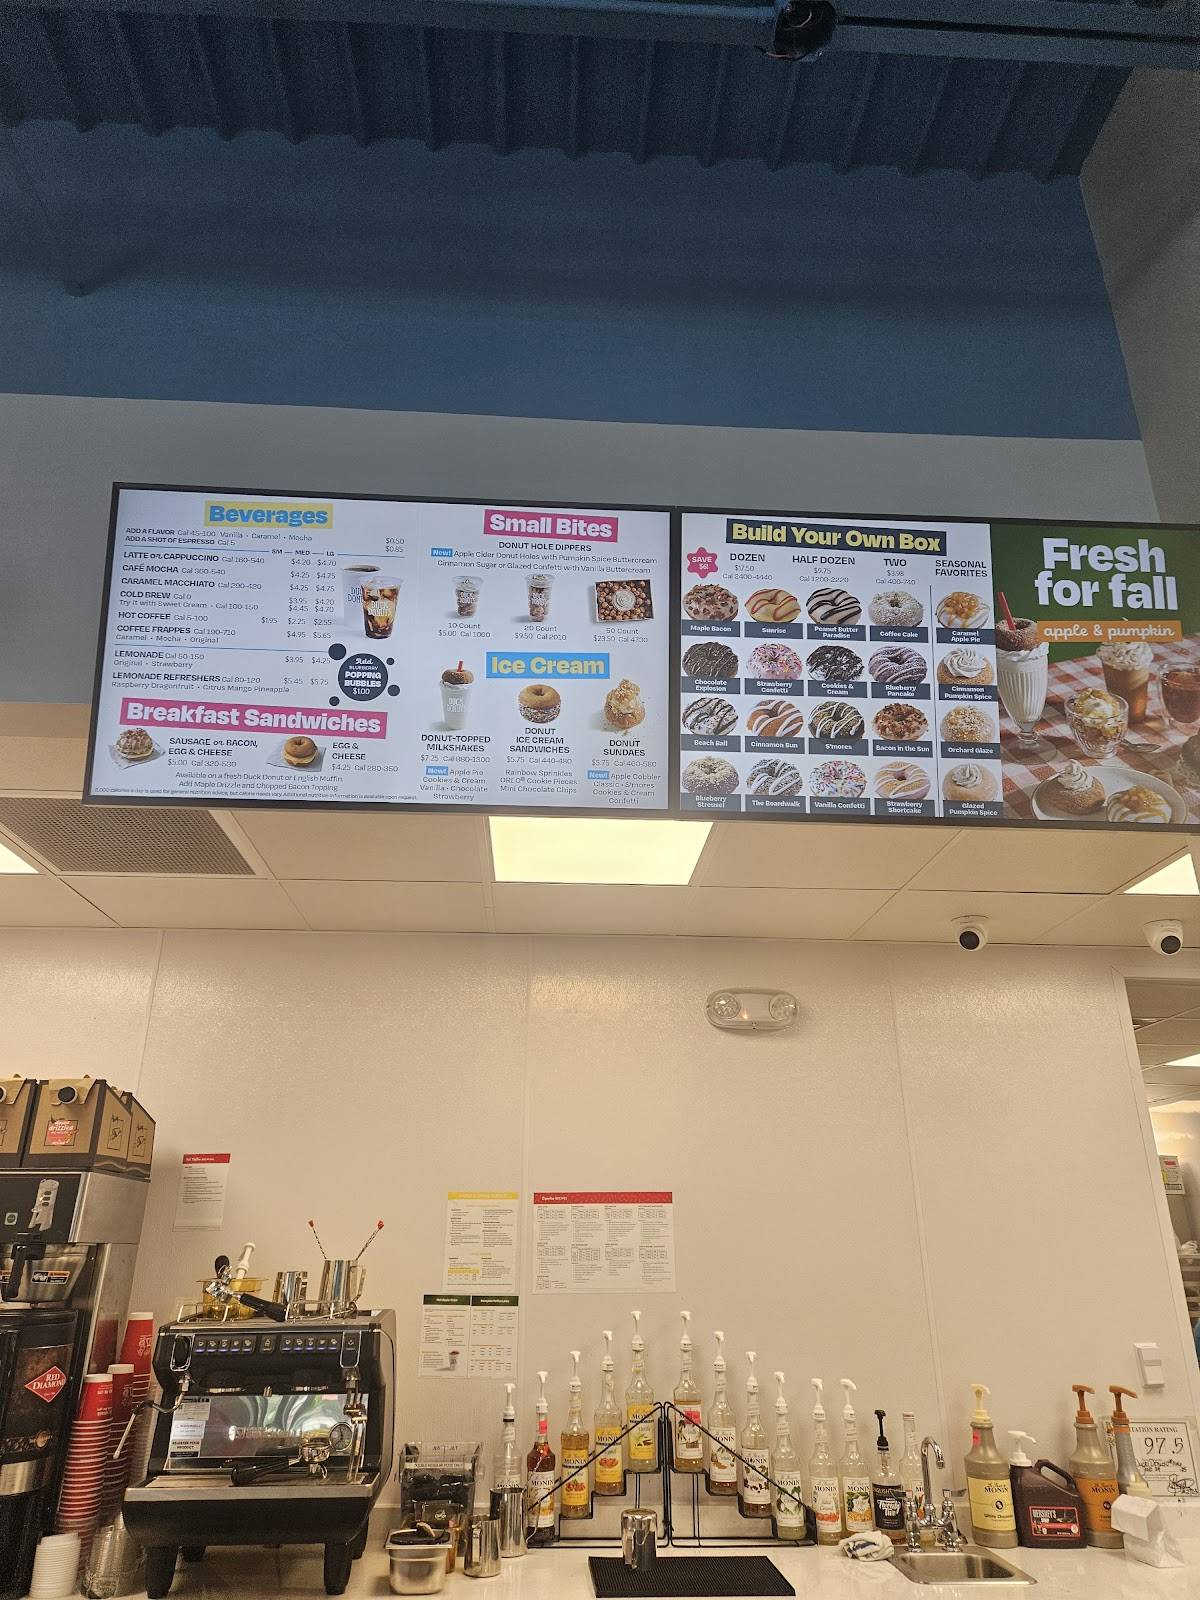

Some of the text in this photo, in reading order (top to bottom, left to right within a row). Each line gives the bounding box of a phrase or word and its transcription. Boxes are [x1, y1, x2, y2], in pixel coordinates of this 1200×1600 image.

[209, 505, 328, 527] Beverages
[490, 514, 613, 538] Small Bites
[147, 528, 175, 536] FLAVOR
[148, 536, 165, 544] SHOT
[178, 537, 215, 545] ESPRESSO
[732, 523, 941, 552] Build Your Own Box
[499, 542, 592, 552] DONUT HOLE DIPPERS
[123, 551, 148, 560] LATTE
[163, 553, 219, 563] CAPPUCCINO
[454, 551, 474, 559] Apple
[559, 554, 590, 563] Pumpkin
[612, 556, 657, 564] Buttercream
[730, 553, 765, 562] DOZEN
[1043, 538, 1165, 573] Fresh
[477, 561, 497, 569] Sugar
[792, 556, 856, 565] HALF DOZEN
[883, 558, 907, 567] TWO
[935, 559, 987, 569] SEASONAL
[122, 563, 145, 572] CAFÉ
[146, 565, 179, 574] MOCHA
[935, 569, 988, 577] FAVORITES
[121, 577, 161, 586] CARAMEL
[163, 579, 215, 588] MACCHIATO
[120, 590, 171, 600] COLD BREW
[1035, 571, 1178, 610] for fall
[118, 611, 171, 621] HOT COFFEE
[117, 624, 191, 634] COFFEE FRAPPES
[814, 625, 837, 633] Peanut
[1044, 625, 1175, 640] apple & pumpkin
[880, 630, 900, 638] Coffee
[114, 650, 164, 659] LEMONADE
[113, 659, 193, 669] Original Strawberry
[492, 657, 604, 674] Ice Cream
[112, 672, 221, 683] LEMONADE REFRESHERS
[345, 671, 382, 680] POPPING
[344, 679, 382, 688] BUBBLES
[695, 679, 727, 687] Chocolate
[757, 681, 792, 689] Strawberry
[696, 685, 727, 693] Explosion
[126, 702, 381, 733] Breakfast Sandwiches
[169, 737, 211, 746] SAUSAGE
[421, 735, 491, 743] DONUT-TOPPED
[332, 742, 351, 750] EGG
[426, 744, 485, 752] MILKSHAKES
[509, 745, 570, 753] SANDWICHES
[168, 748, 232, 757] EGG CHEESE
[331, 752, 366, 761] CHEESE
[603, 748, 645, 756] SUNDAES
[176, 771, 206, 779] Available
[449, 768, 469, 776] Apple
[423, 776, 453, 784] Cookies
[194, 781, 216, 789] Maple
[433, 793, 474, 801] Strawberry
[887, 801, 922, 809] Strawberry
[46, 1373, 60, 1381] RED
[33, 1379, 66, 1389] DIAMOND
[1144, 1437, 1184, 1455] 97.5
[1033, 1510, 1056, 1518] HERSHEY'S
